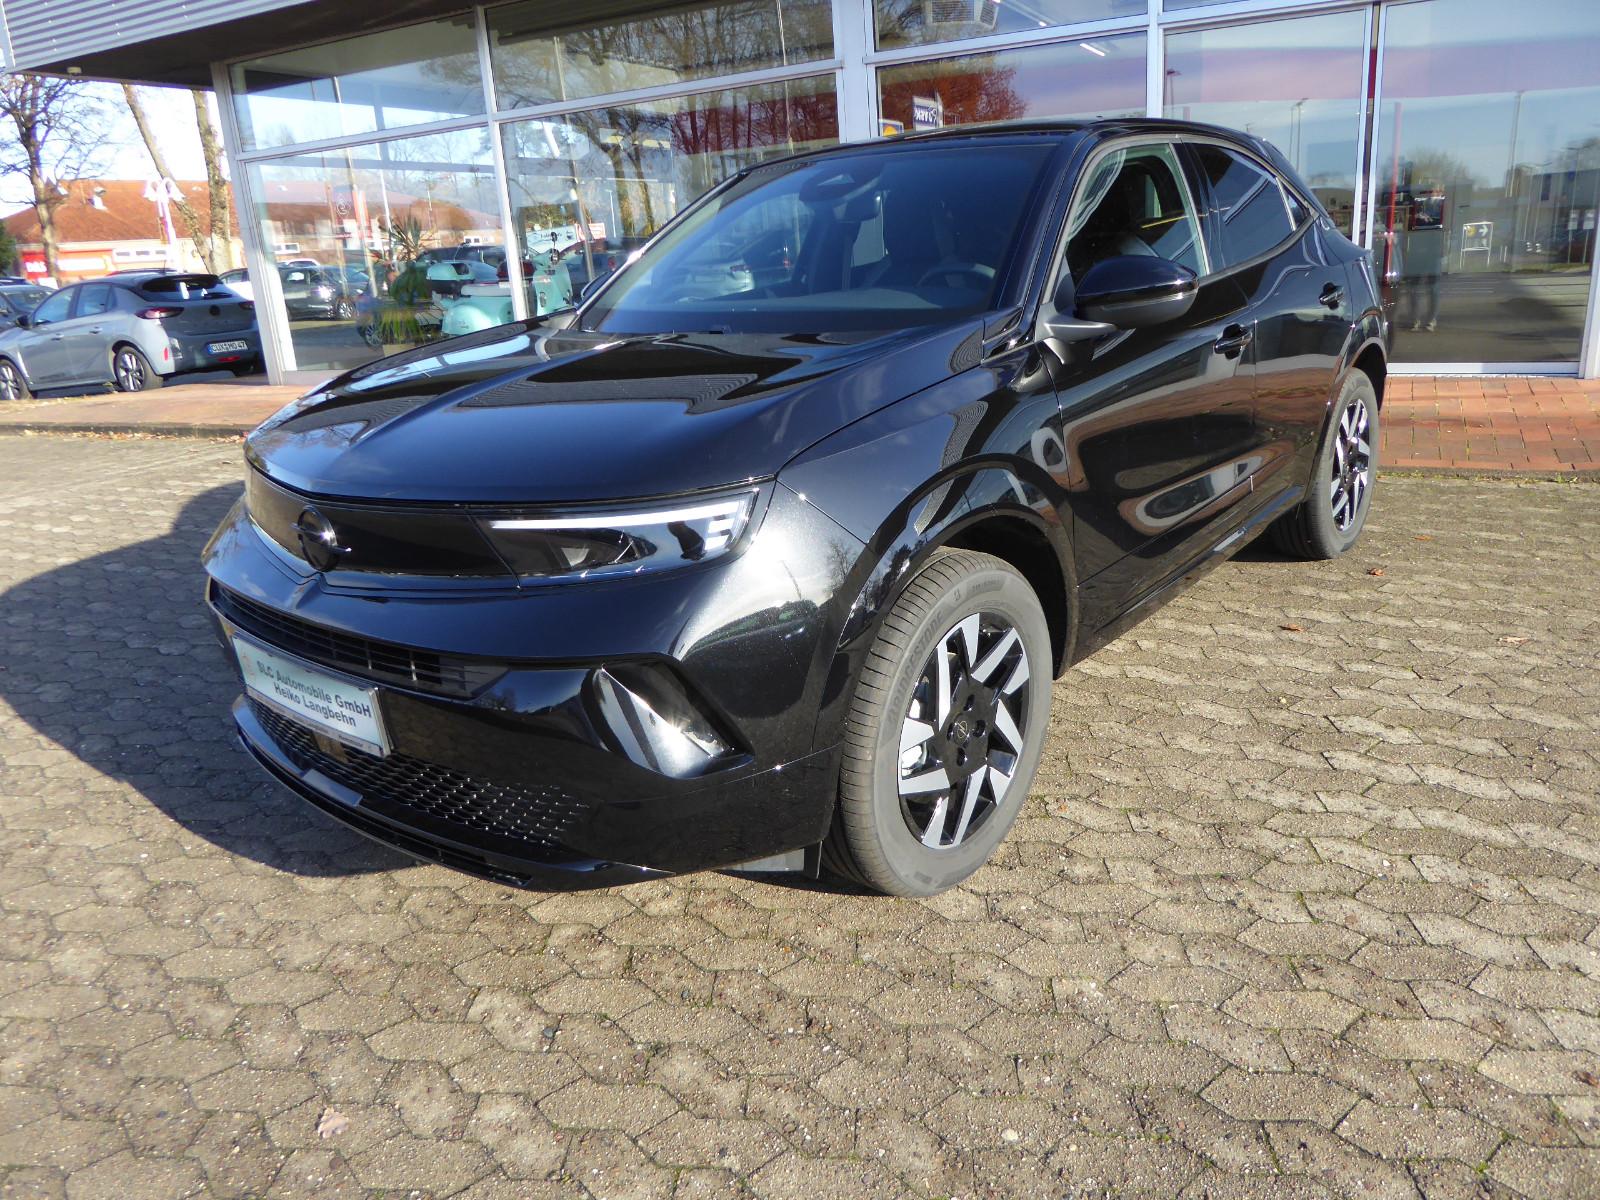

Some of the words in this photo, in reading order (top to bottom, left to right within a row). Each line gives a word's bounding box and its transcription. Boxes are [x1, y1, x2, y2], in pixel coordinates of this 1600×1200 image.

[273, 682, 301, 705] Heiko
[302, 698, 357, 727] Langbehn
[276, 670, 333, 704] Automobile
[334, 695, 372, 718] GmbH
